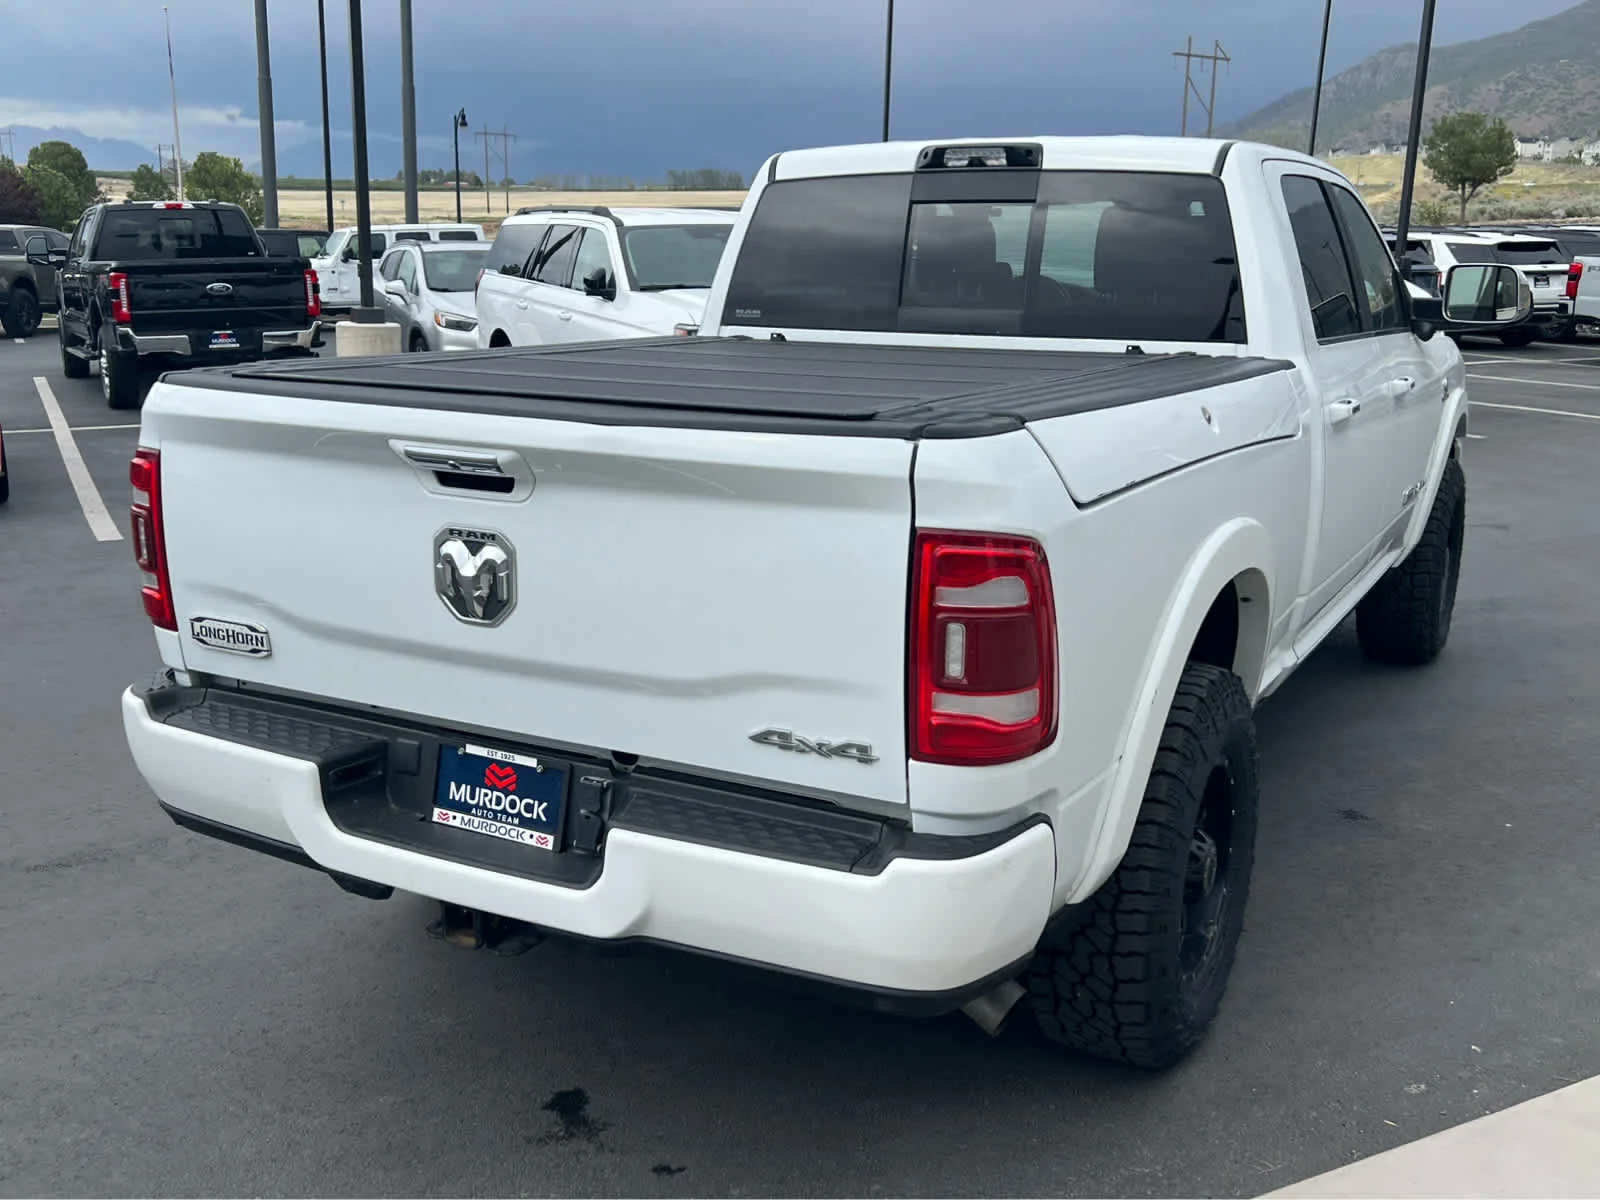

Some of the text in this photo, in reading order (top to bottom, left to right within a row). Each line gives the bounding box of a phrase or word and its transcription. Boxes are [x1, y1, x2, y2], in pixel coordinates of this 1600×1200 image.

[448, 528, 497, 540] RAM
[500, 752, 516, 762] 1925
[449, 781, 549, 822] MURDOCK
[471, 807, 520, 825] AUTO TEAM
[459, 815, 527, 842] MURDOCK
